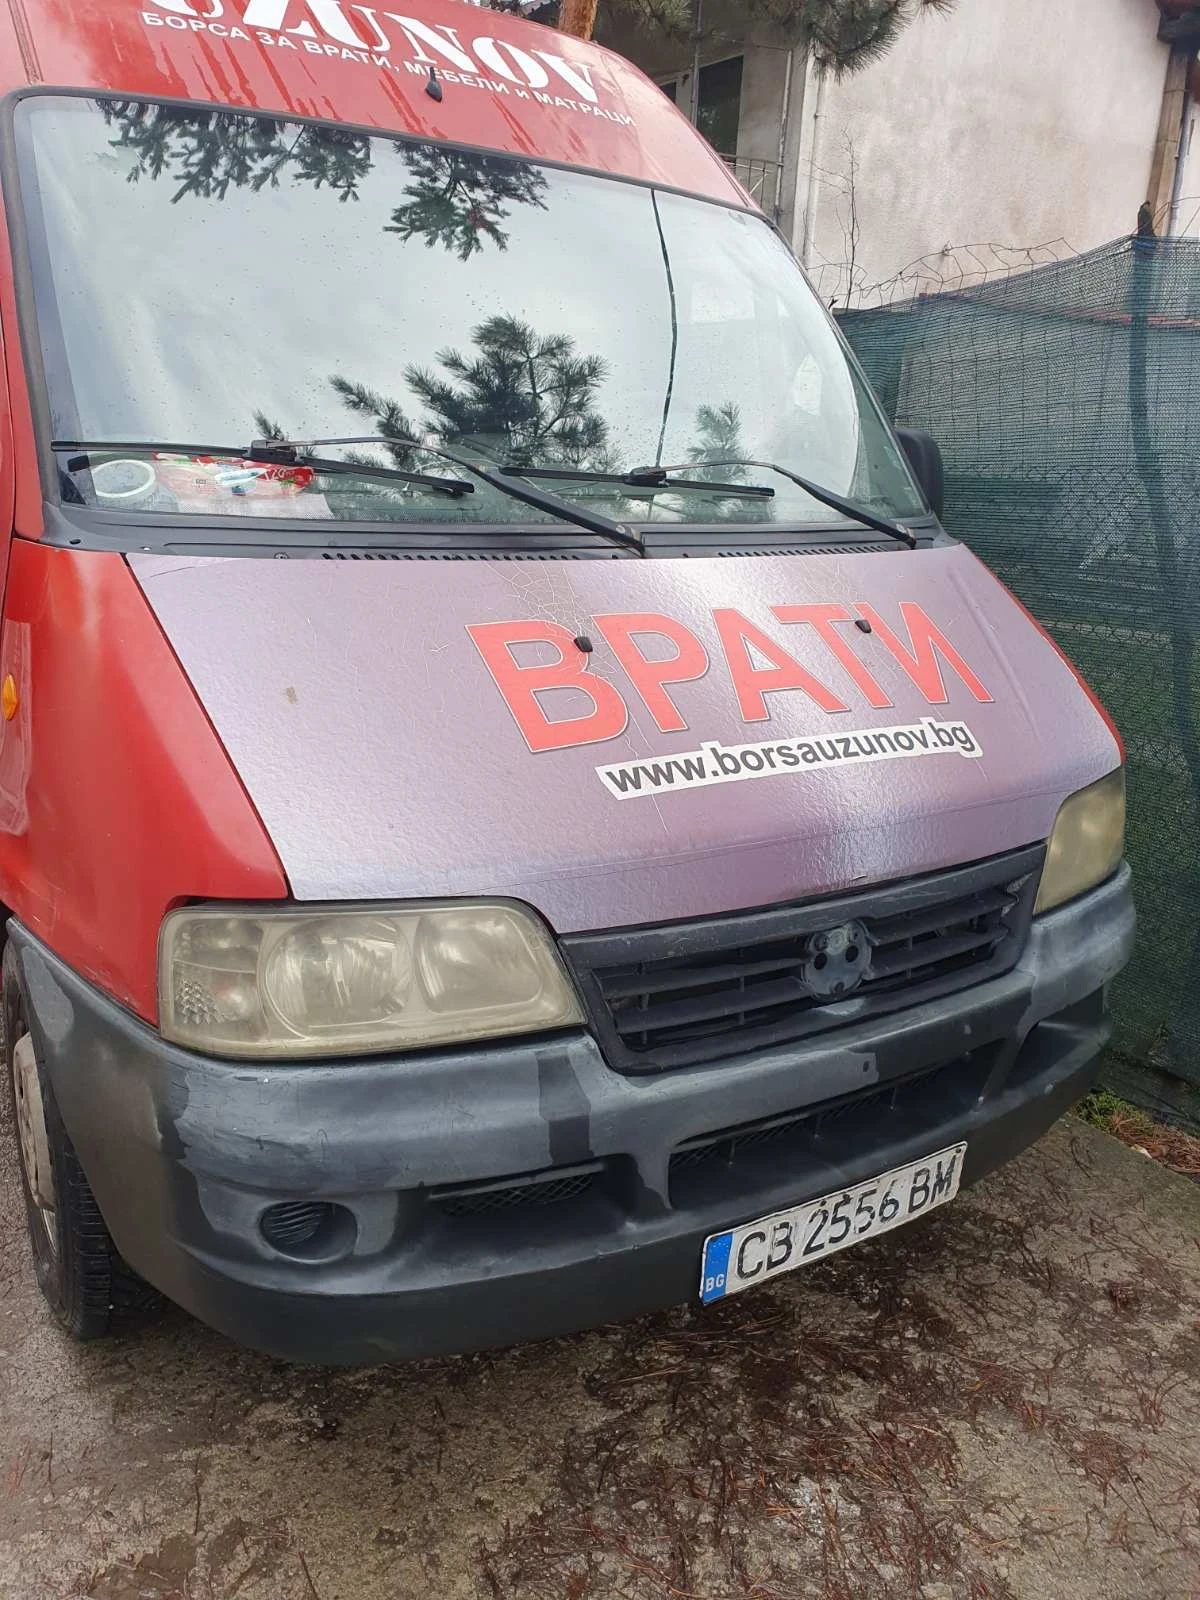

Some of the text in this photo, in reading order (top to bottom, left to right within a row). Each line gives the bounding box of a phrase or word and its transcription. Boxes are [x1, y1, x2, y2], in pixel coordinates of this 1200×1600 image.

[141, 12, 251, 41] БОРСА
[256, 31, 298, 50] ЗА
[302, 40, 400, 72] ВРАТИ,
[532, 93, 636, 126] МАТРАЦИ
[464, 600, 995, 753] ВРАТИ
[605, 720, 974, 793] www.borsauzunov.bg
[802, 1181, 900, 1257] 2556
[705, 1273, 725, 1292] BG
